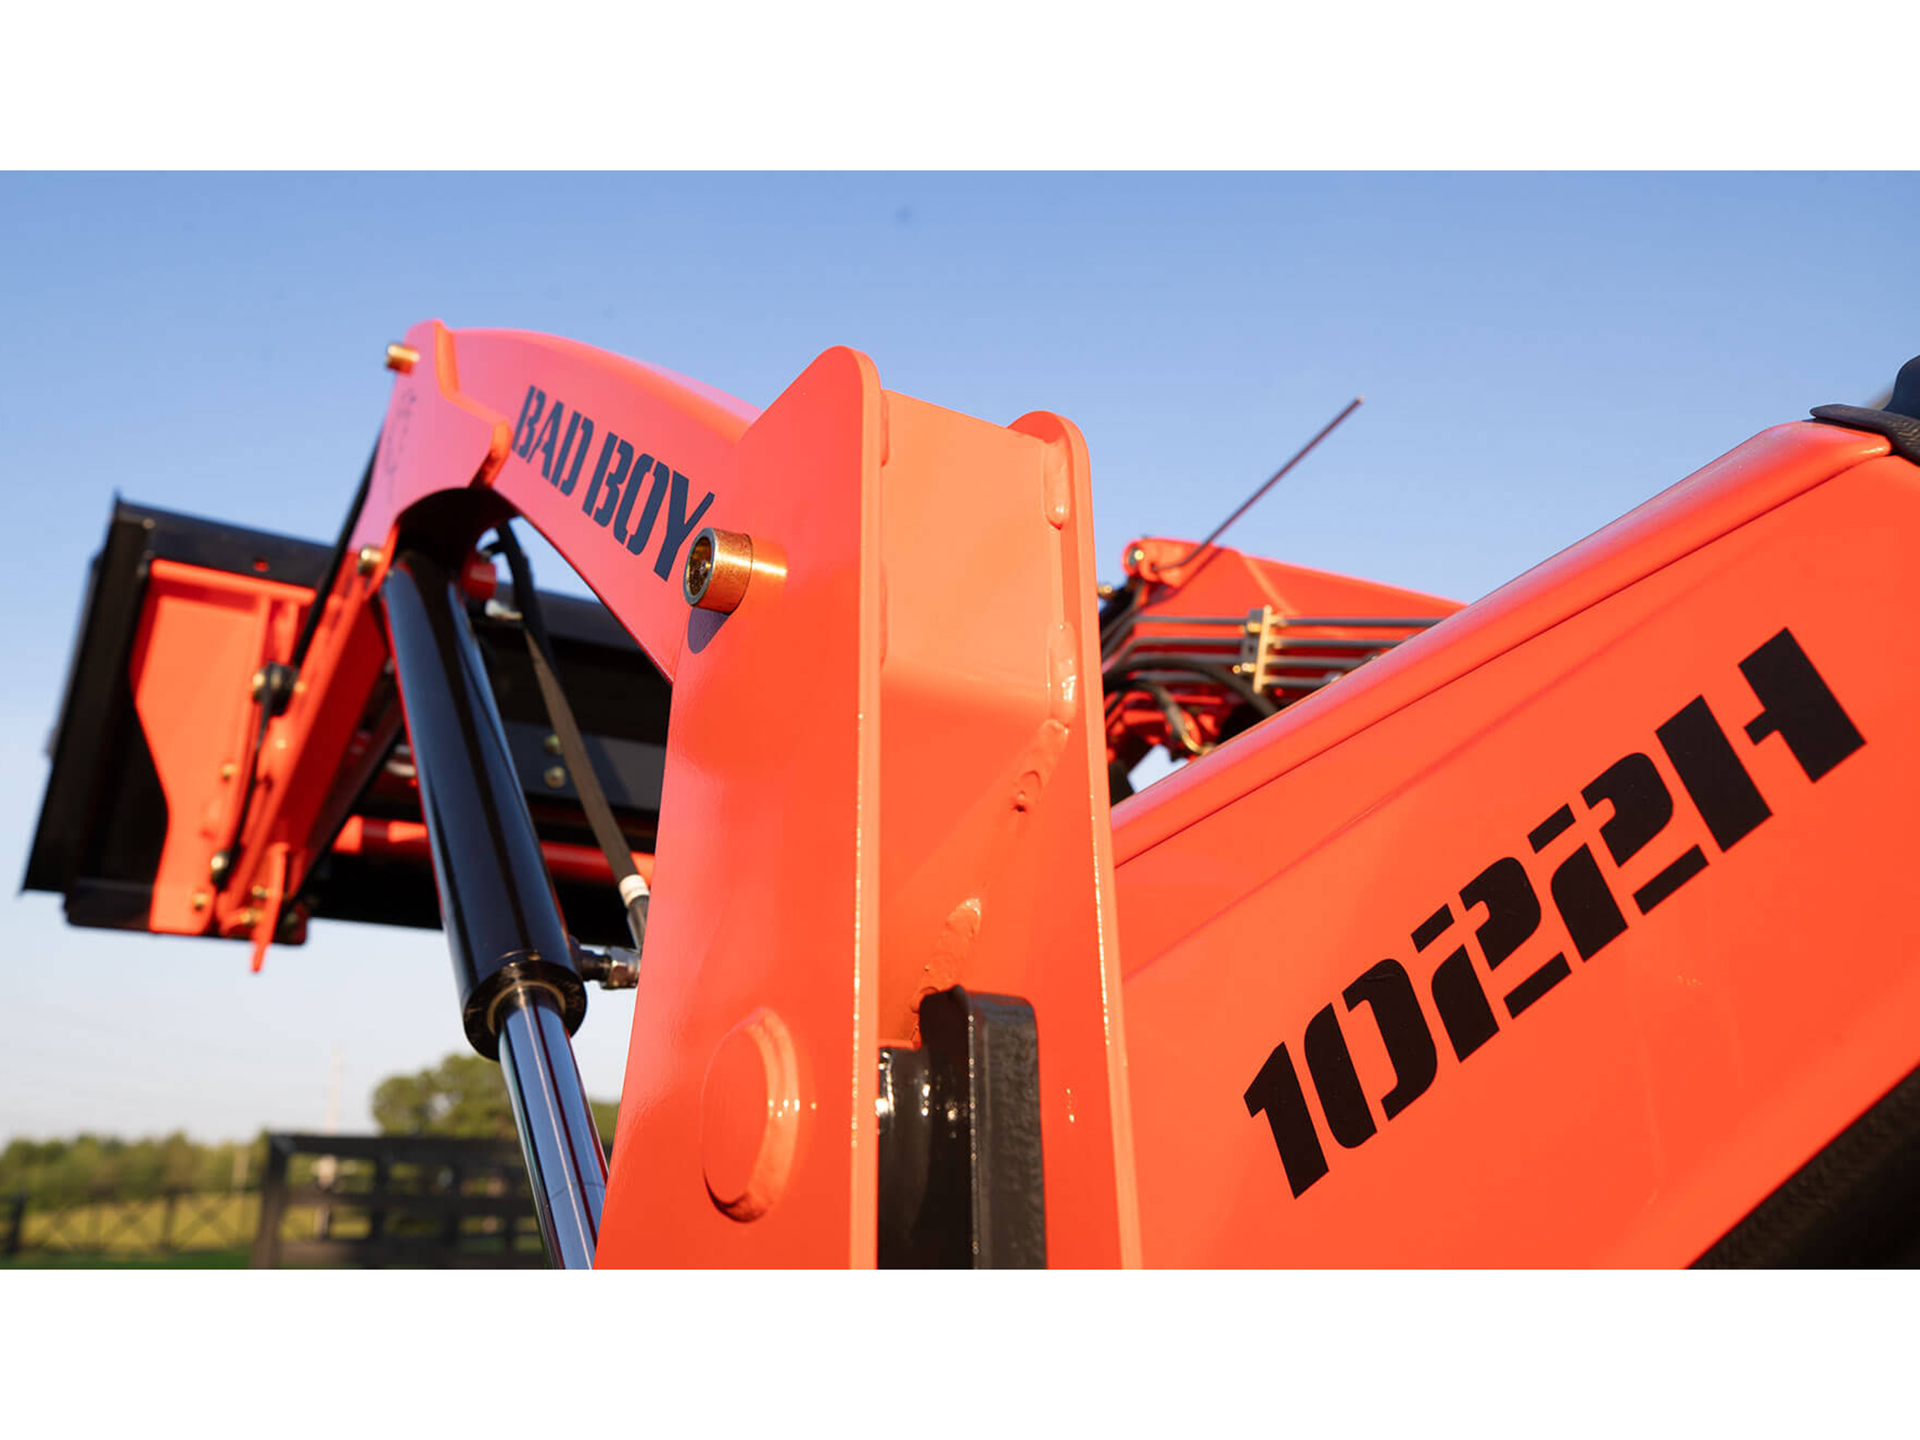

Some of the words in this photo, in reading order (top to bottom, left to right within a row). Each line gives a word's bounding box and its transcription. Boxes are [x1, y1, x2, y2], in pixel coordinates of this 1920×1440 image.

[511, 385, 595, 498] BAD
[583, 432, 715, 581] BOY
[1244, 627, 1866, 1200] 1022H
